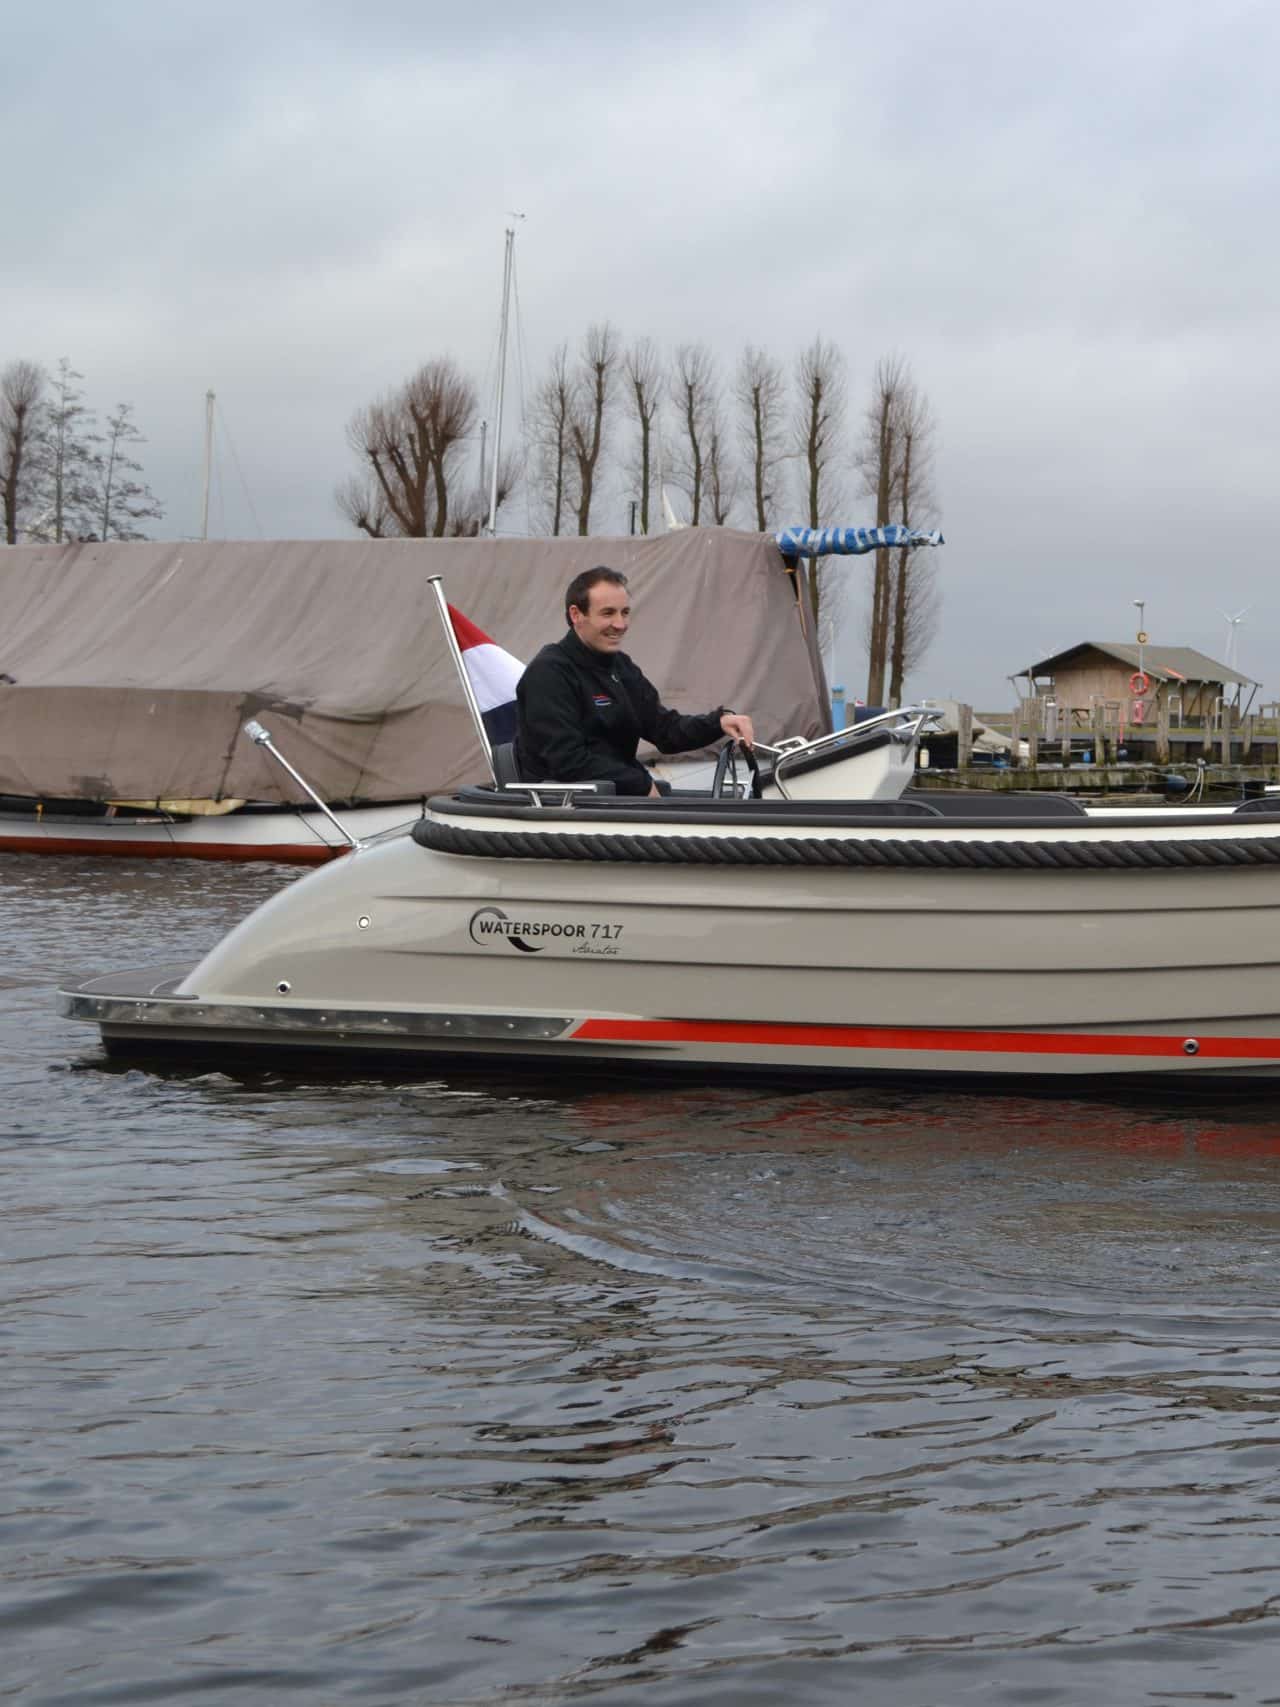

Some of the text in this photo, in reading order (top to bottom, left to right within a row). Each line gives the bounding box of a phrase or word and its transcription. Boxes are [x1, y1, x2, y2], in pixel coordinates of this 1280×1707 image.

[1137, 632, 1147, 643] C
[479, 921, 624, 939] WATERSPOOR 717
